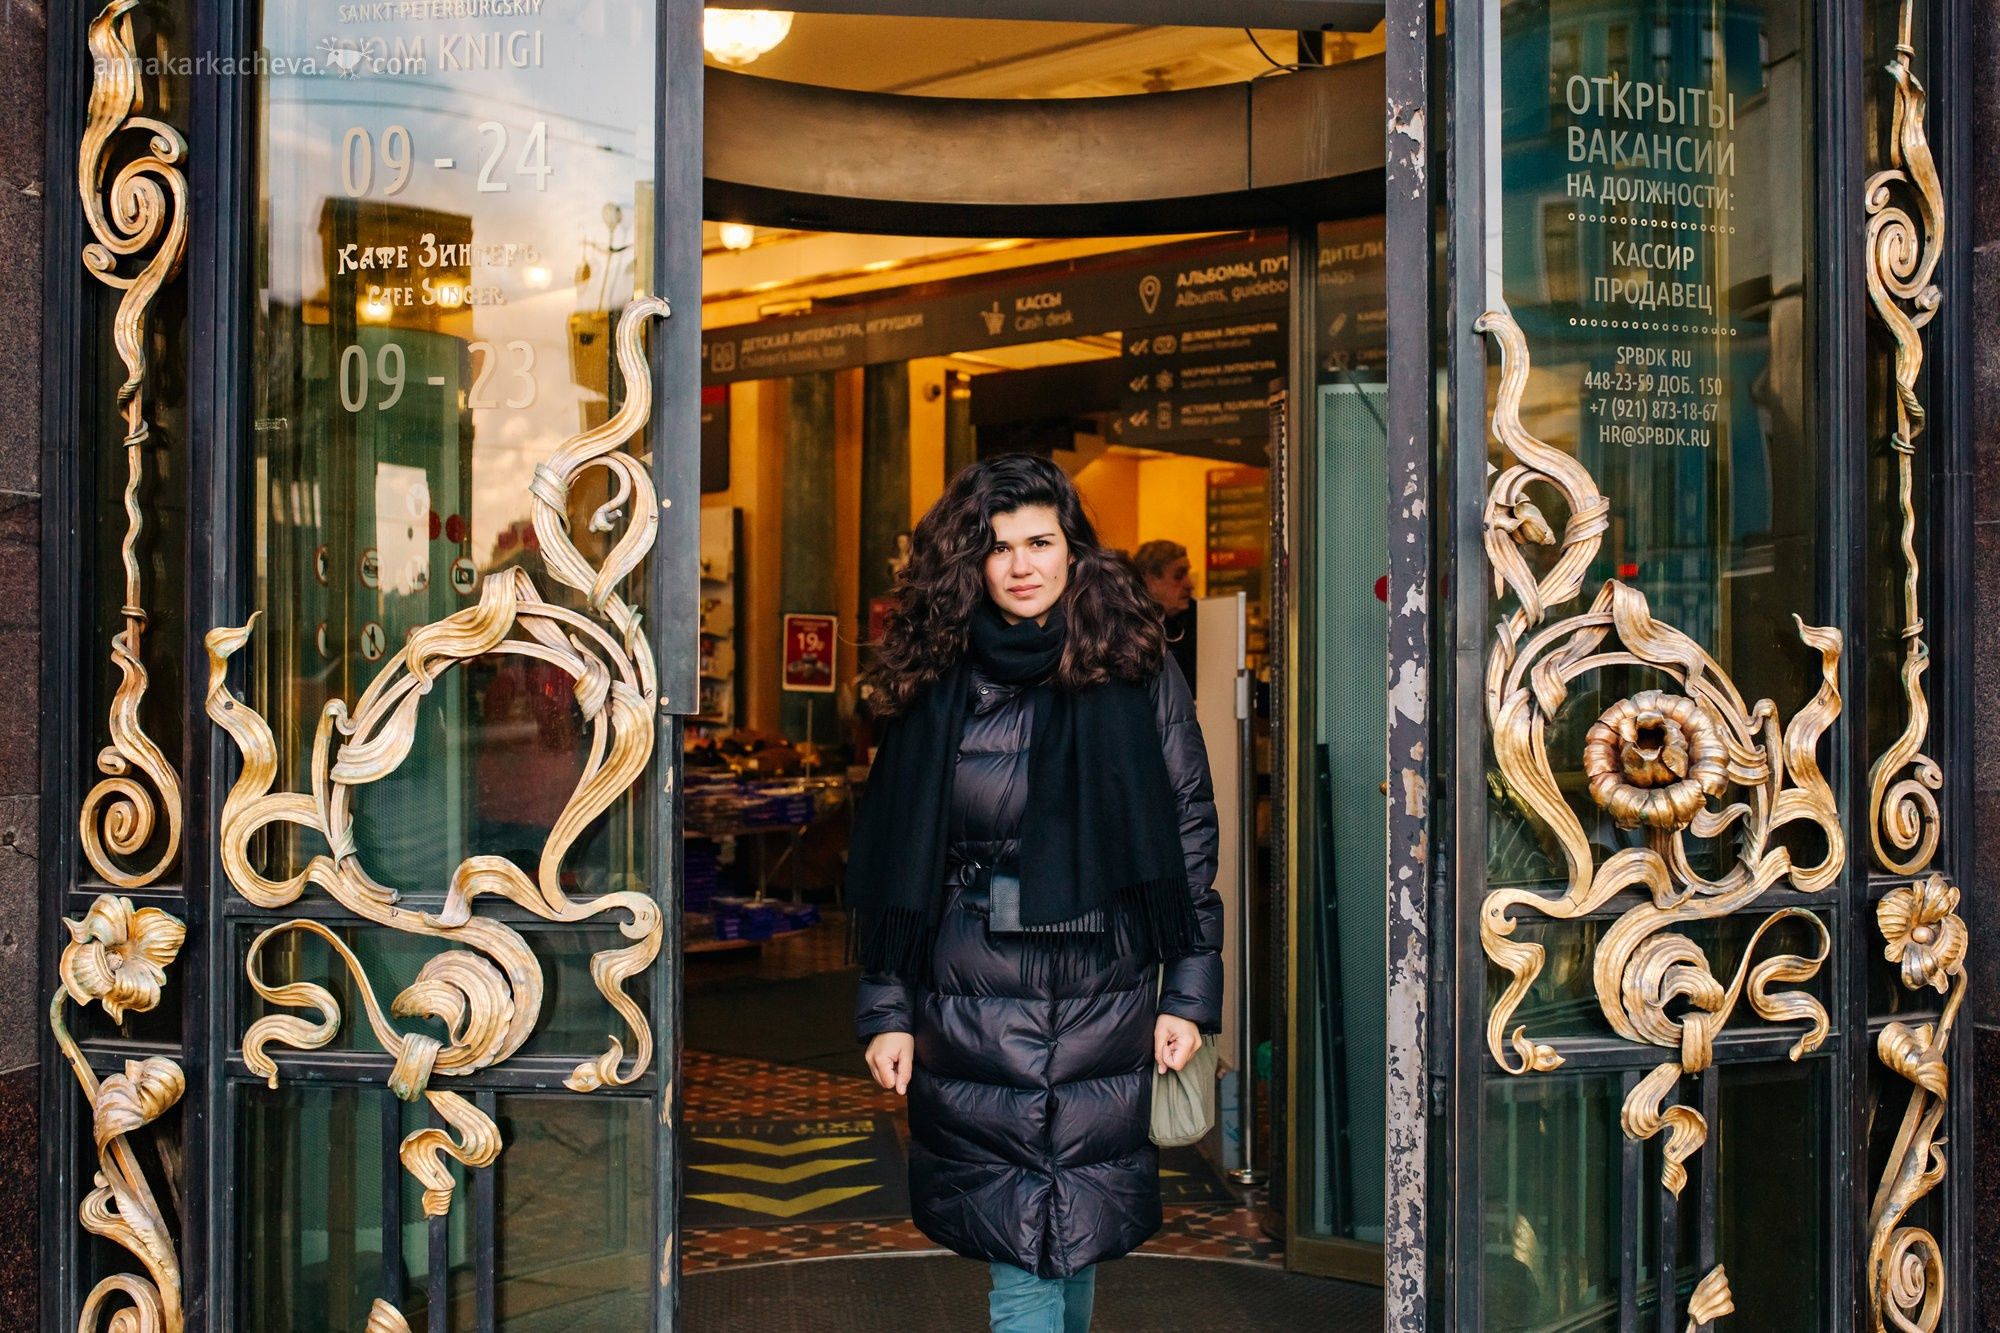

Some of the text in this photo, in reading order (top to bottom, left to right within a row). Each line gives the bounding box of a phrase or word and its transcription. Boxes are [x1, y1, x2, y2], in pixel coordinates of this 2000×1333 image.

[338, 0, 543, 23] SANKT-PETERBURGSKIY
[438, 30, 543, 71] KNIGI
[1566, 74, 1735, 131] ОТКРЫТЫ
[341, 124, 412, 198] 09
[476, 121, 553, 193] 24
[1567, 125, 1735, 177] ВАКАНСИИ
[1567, 173, 1735, 212] НА ДОЛЖНОСТИ:
[1176, 260, 1258, 289] АЛЬБОМЫ,
[1318, 241, 1384, 268] ДИТЕЛИ
[1612, 240, 1695, 271] КАССИР
[1015, 292, 1062, 312] КАССЫ
[1175, 286, 1229, 308] Albums,
[1594, 276, 1713, 316] ПРОДАВЕЦ
[1616, 345, 1692, 369] SPBDK RU
[339, 343, 406, 413] 09
[467, 340, 537, 409] 23
[1584, 370, 1723, 397] 448-23-59 ДОБ. 150
[1589, 396, 1719, 422] +7 (921) 873-18-67
[1599, 424, 1711, 448] HR@SPBDK.RU
